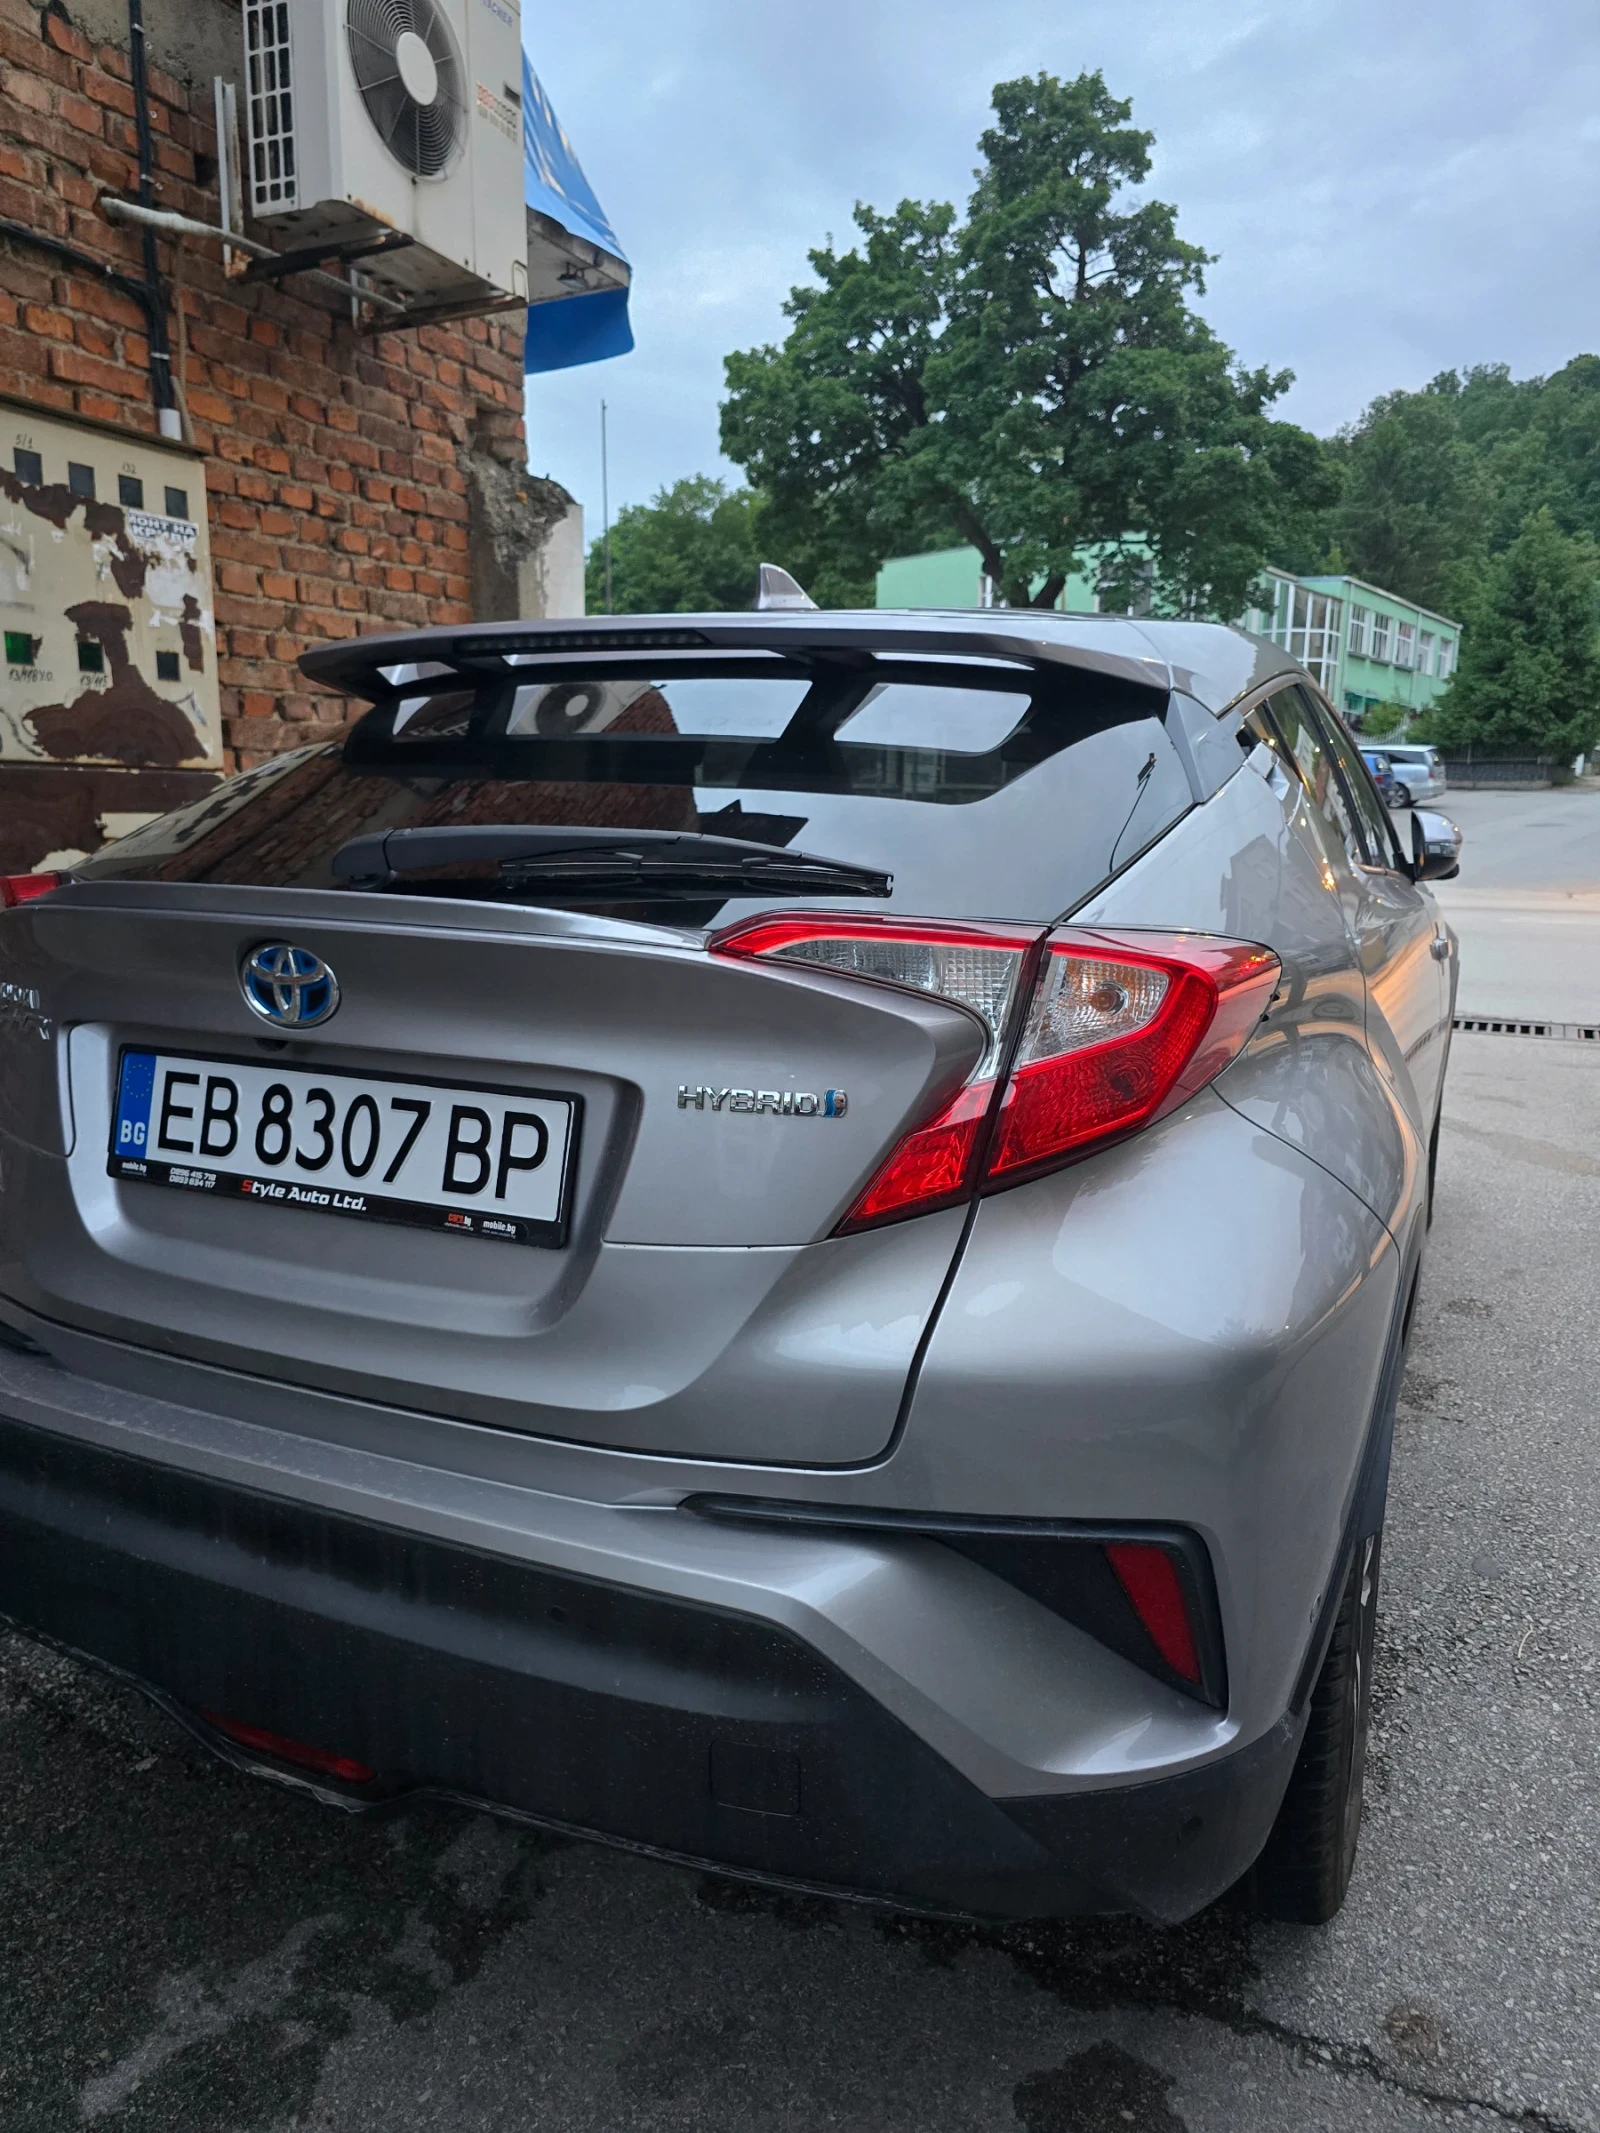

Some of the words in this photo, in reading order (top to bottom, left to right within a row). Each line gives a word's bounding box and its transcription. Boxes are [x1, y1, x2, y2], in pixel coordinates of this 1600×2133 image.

[677, 1084, 820, 1116] HYBRID
[120, 1119, 146, 1145] BG
[157, 1070, 240, 1158] EB
[254, 1083, 432, 1184] 8307
[441, 1104, 550, 1200] BP
[241, 1179, 286, 1198] Style
[287, 1186, 330, 1205] Auto
[332, 1193, 367, 1211] Ltd.
[483, 1220, 516, 1234] mobile.bg
